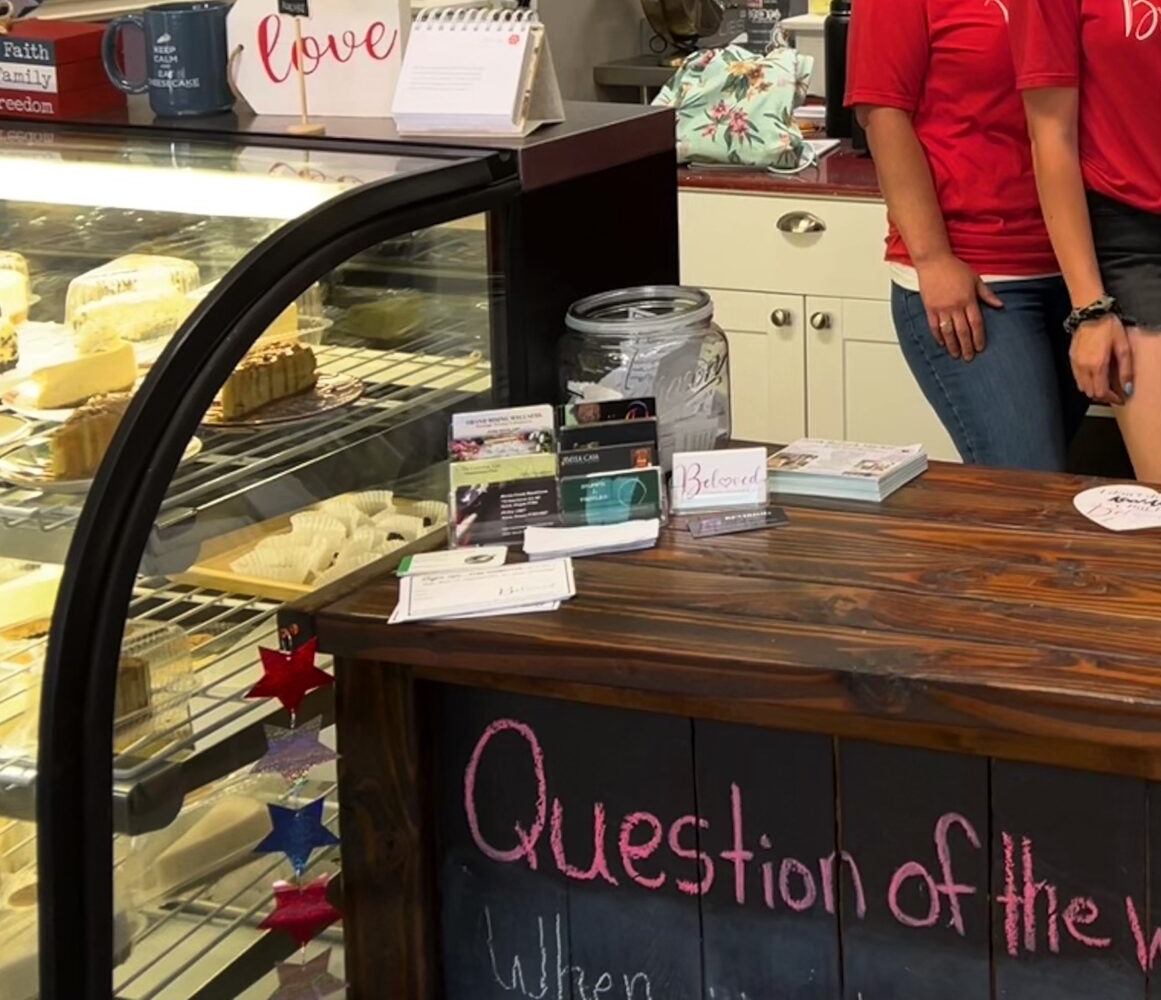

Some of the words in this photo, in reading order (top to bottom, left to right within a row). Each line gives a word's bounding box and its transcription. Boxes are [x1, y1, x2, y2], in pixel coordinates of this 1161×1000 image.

[3, 40, 50, 61] Faith
[153, 45, 177, 54] KEEP
[153, 55, 178, 63] CALM
[257, 14, 398, 83] love
[0, 96, 54, 116] reedom
[675, 463, 768, 501] Beloved
[464, 718, 866, 918] Question
[888, 811, 981, 936] of
[997, 831, 1111, 956] the
